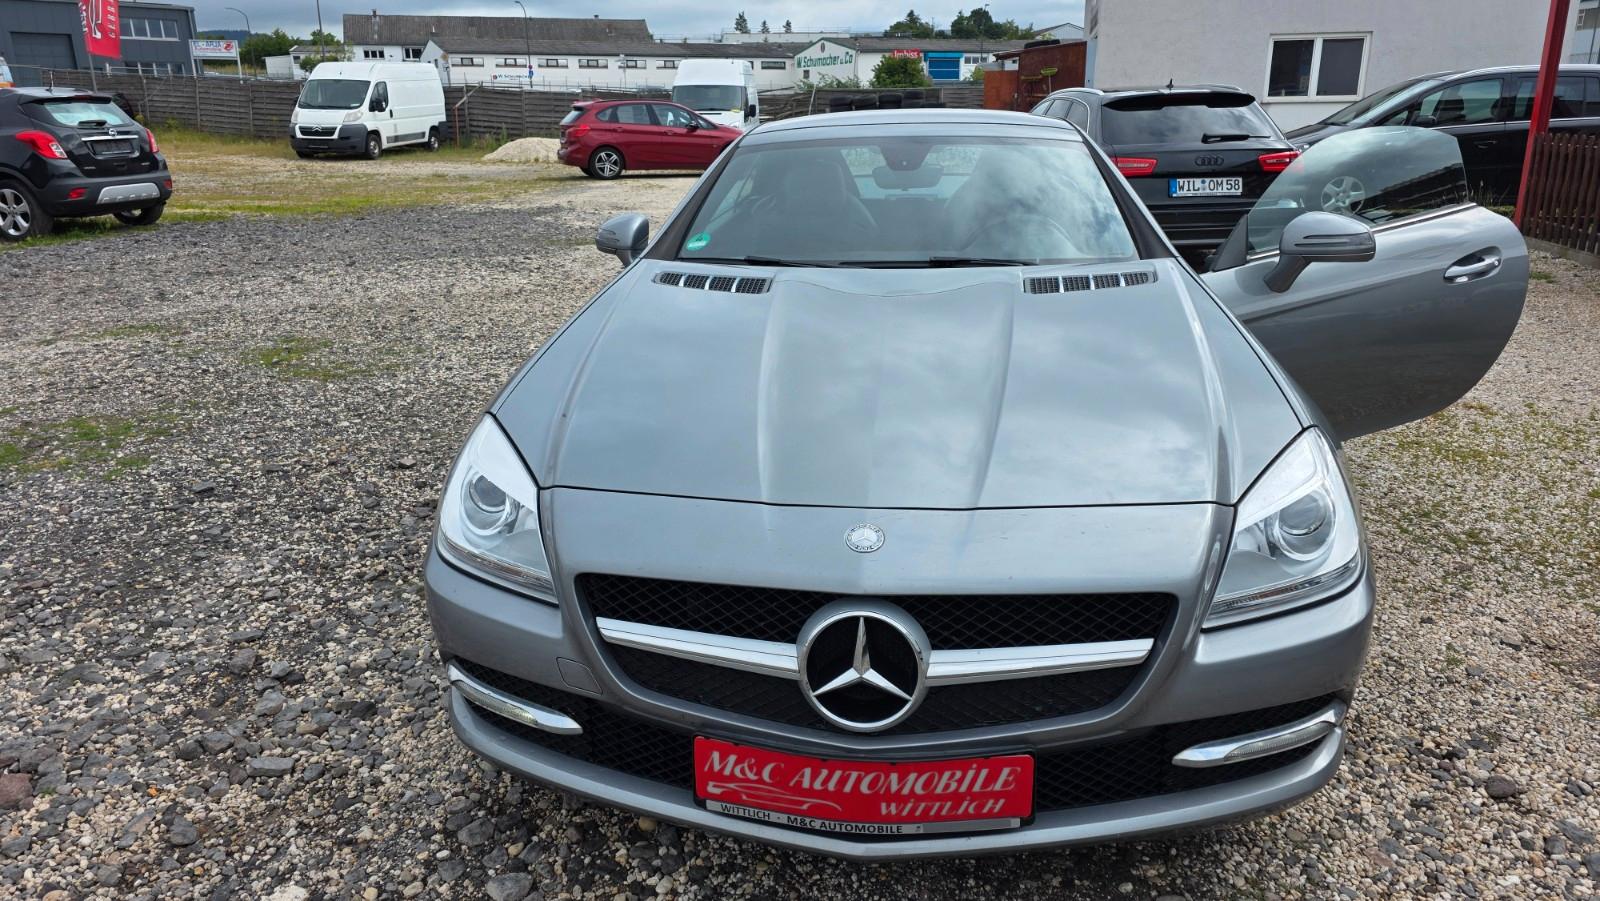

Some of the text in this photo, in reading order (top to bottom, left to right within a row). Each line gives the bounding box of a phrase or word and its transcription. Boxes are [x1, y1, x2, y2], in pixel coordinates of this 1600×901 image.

[803, 53, 840, 68] Schumacher
[1178, 181, 1200, 192] WIL
[703, 751, 785, 783] M&C
[720, 803, 771, 820] WITTLICH
[786, 815, 817, 829] M&C
[819, 822, 904, 834] AUTOMOBILE
